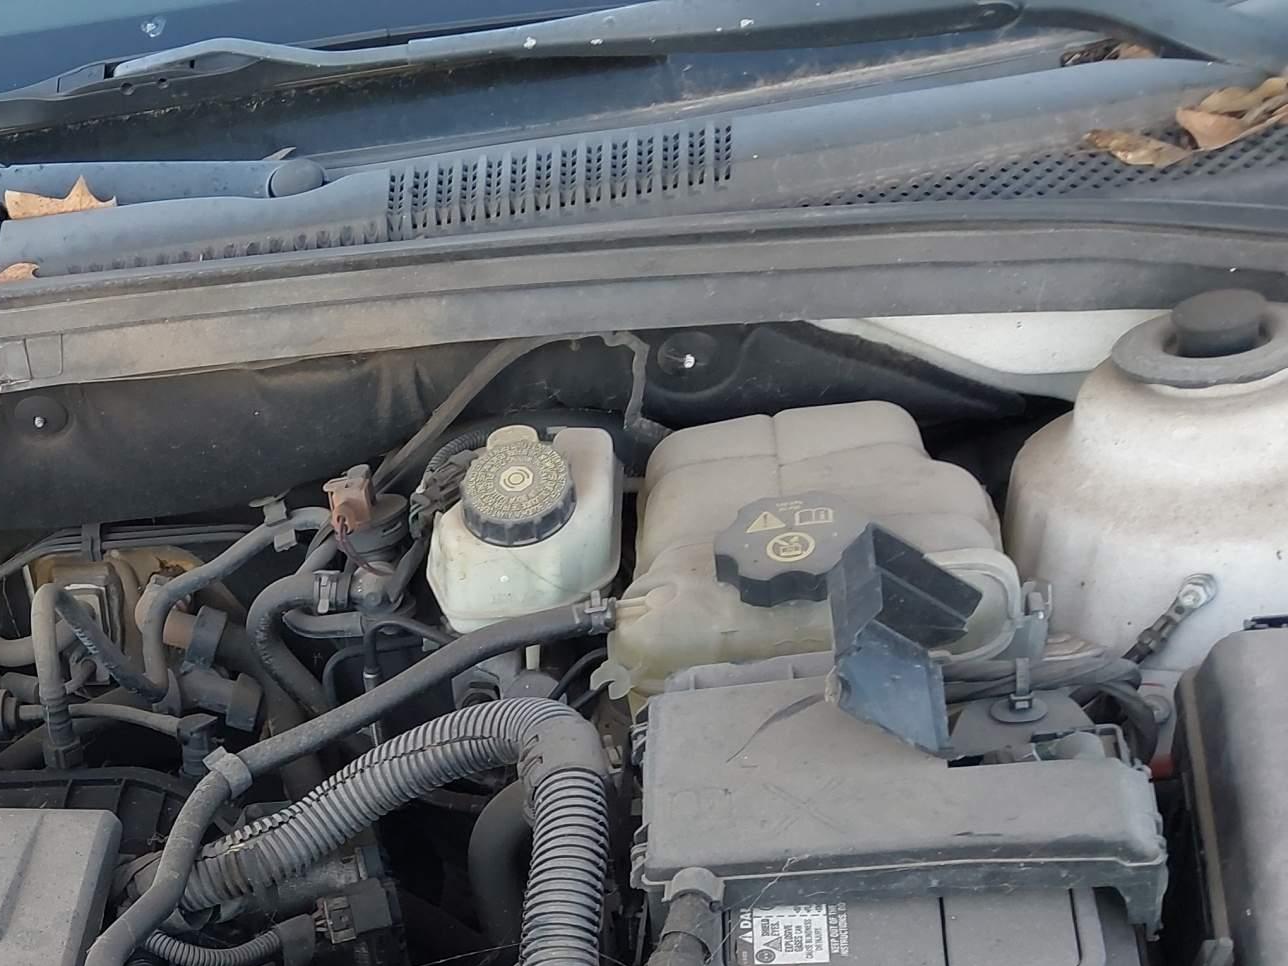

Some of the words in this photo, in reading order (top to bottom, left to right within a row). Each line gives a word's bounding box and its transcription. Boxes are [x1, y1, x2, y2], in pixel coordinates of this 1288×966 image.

[761, 919, 770, 937] SHIELD
[794, 925, 802, 935] CAN
[784, 925, 793, 953] EXPLOSIVE
[794, 936, 803, 953] GASES
